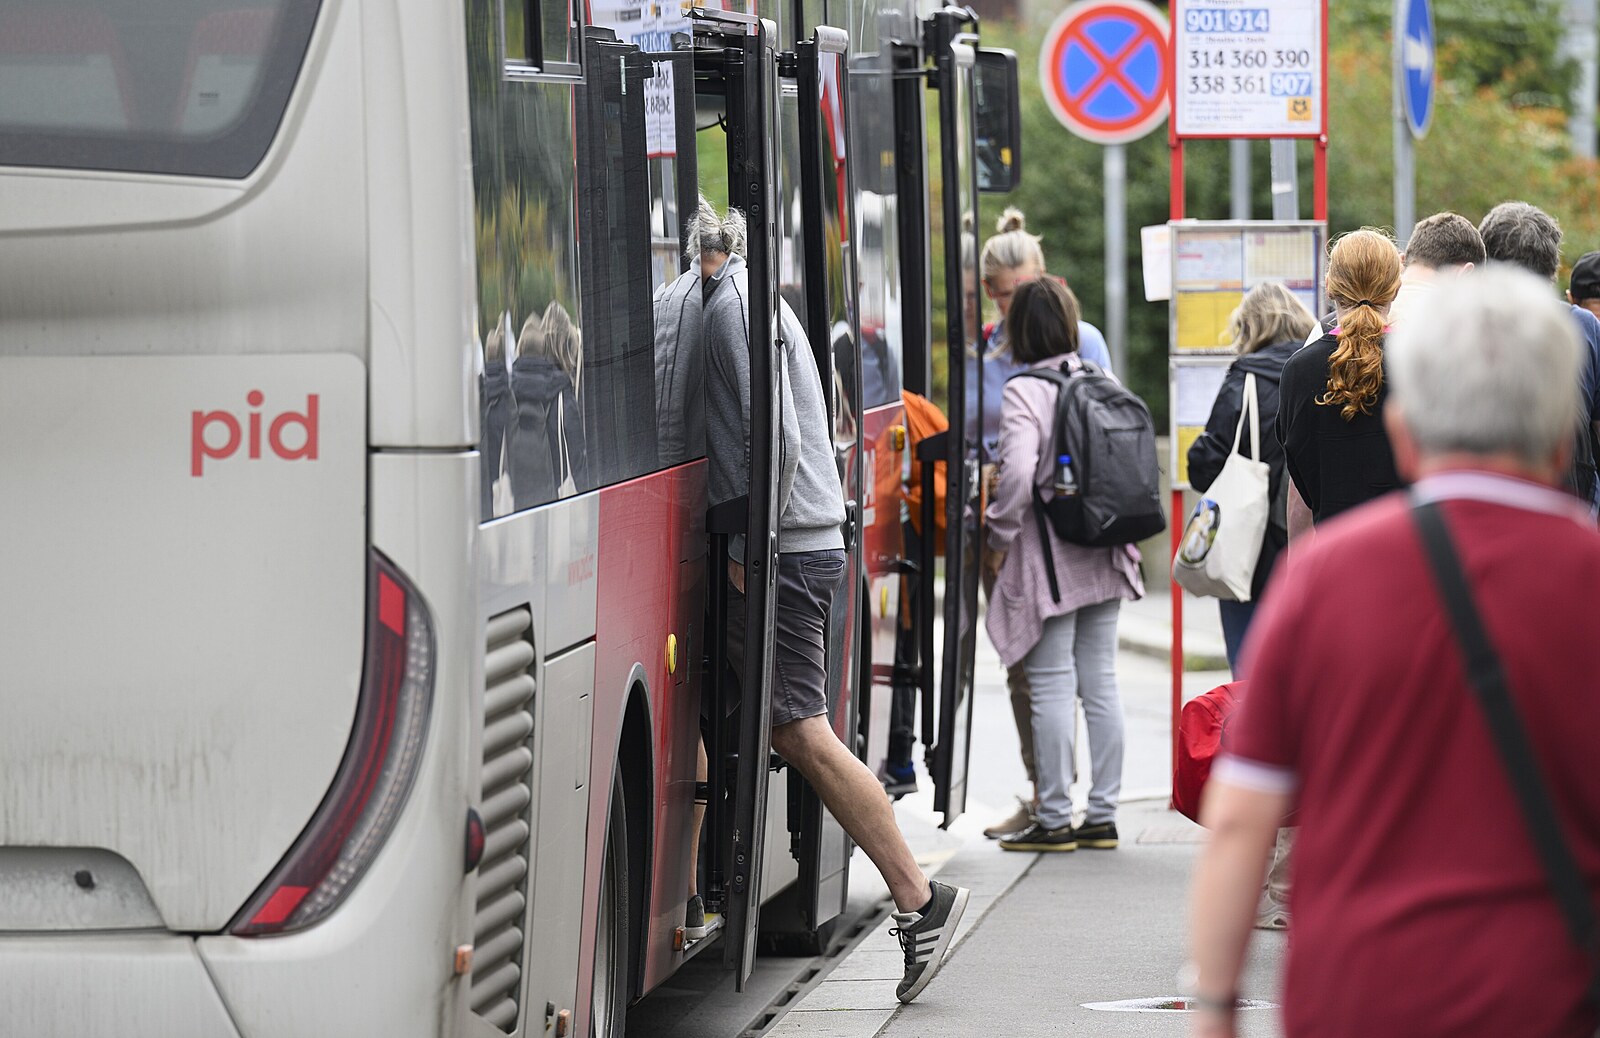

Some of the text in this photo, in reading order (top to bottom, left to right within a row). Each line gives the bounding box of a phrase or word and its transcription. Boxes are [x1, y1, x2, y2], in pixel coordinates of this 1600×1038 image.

[1187, 10, 1268, 31] 901 914
[1189, 50, 1310, 68] 314 360 390
[1189, 74, 1311, 95] 338 361 907
[191, 389, 320, 477] pid
